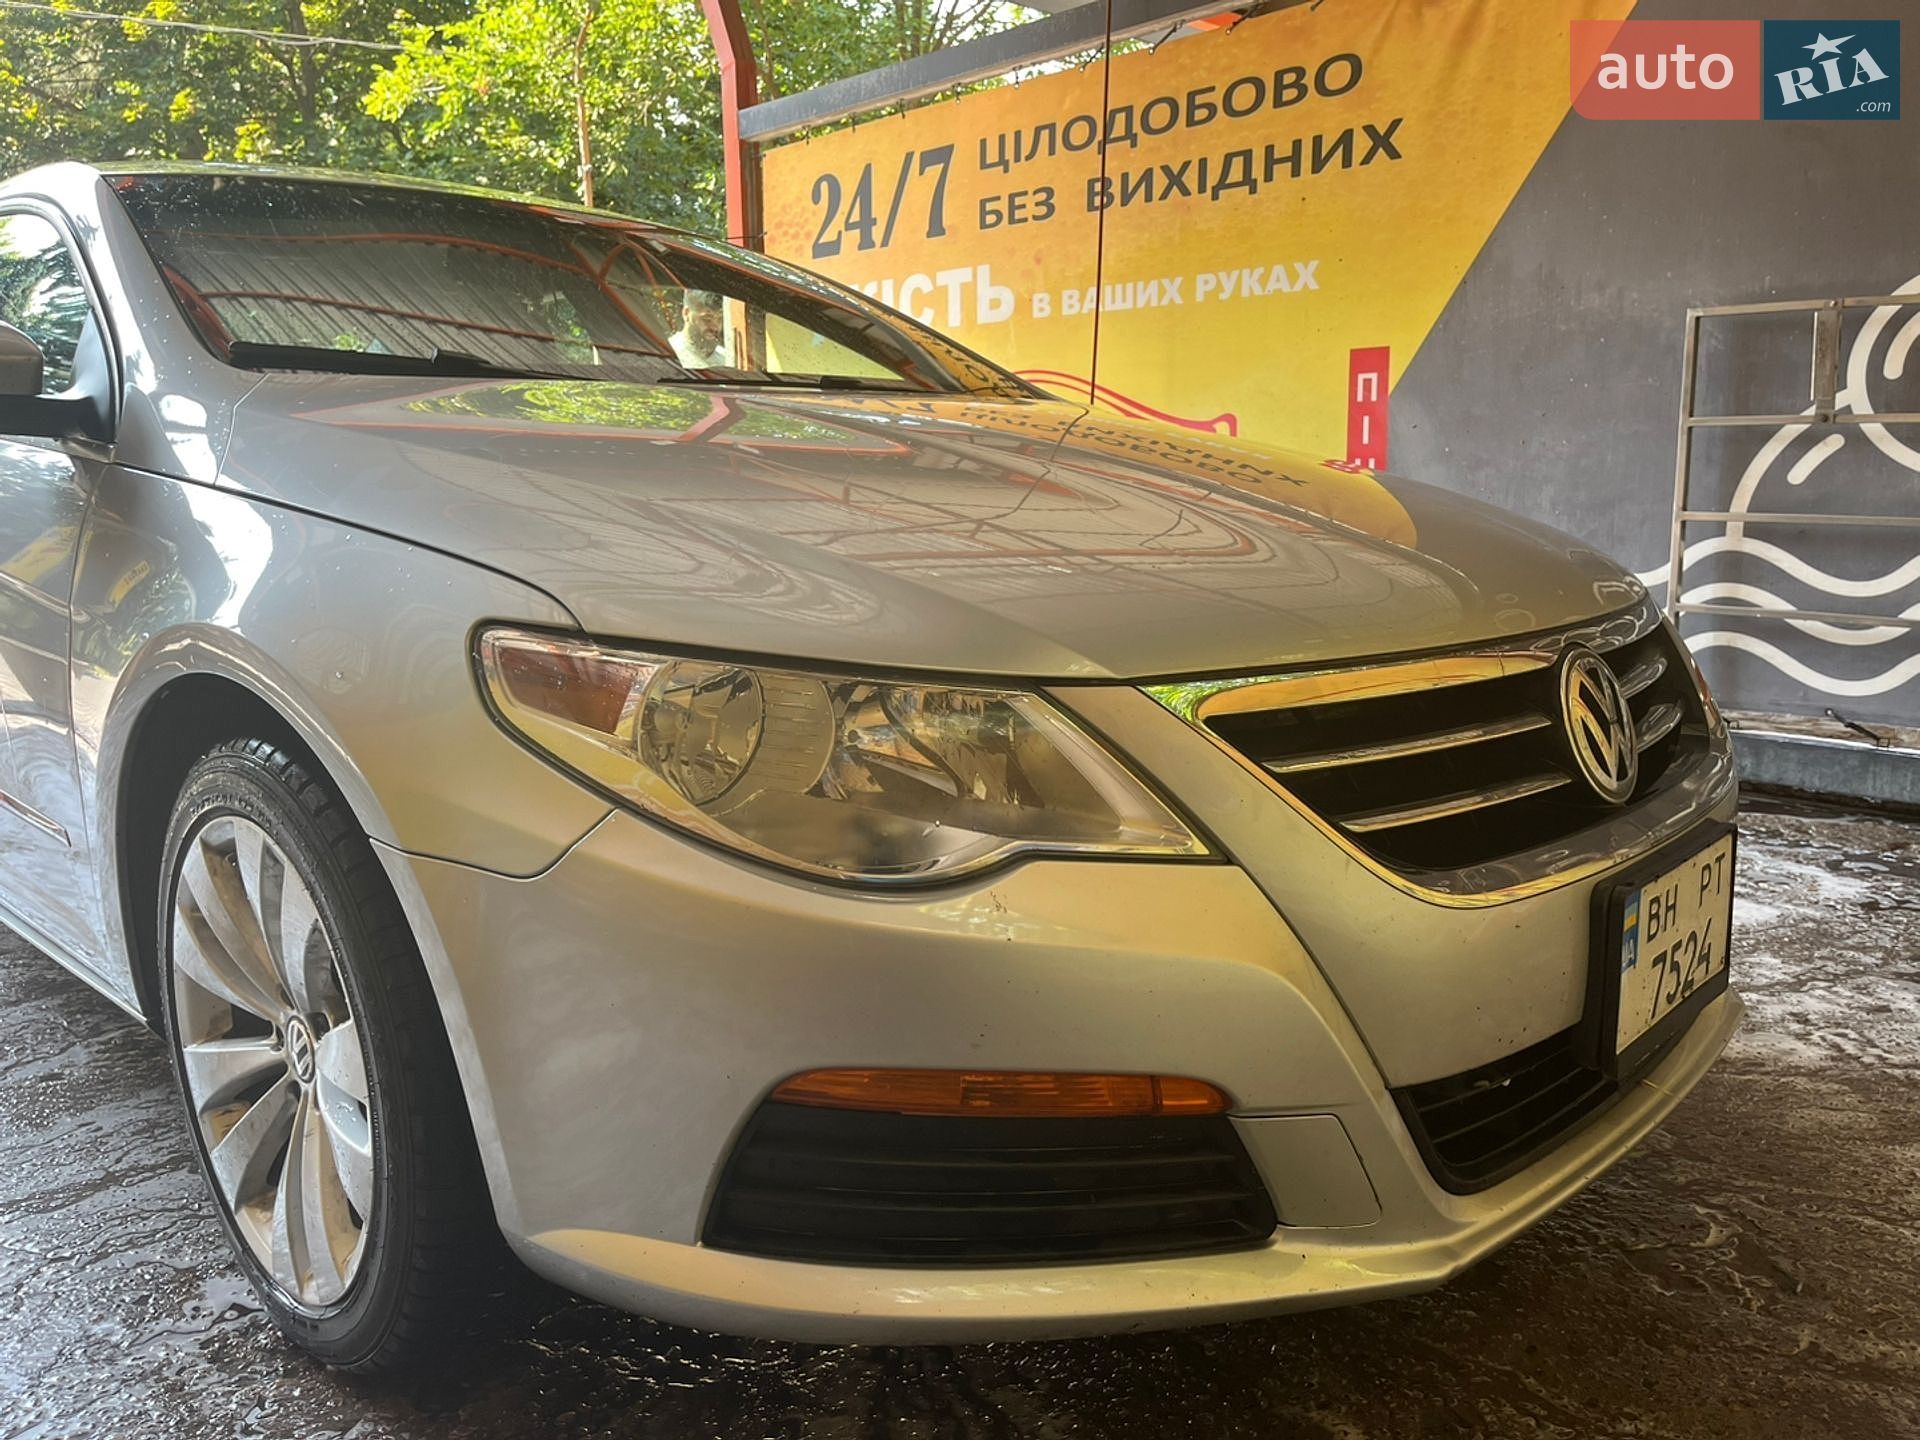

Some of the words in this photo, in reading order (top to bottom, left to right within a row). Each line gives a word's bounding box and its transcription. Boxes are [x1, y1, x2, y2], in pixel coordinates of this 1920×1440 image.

[978, 53, 1363, 174] ЦІЛОДОБОВО
[811, 143, 955, 259] 24/7
[978, 186, 1056, 230] БЕЗ
[1086, 117, 1404, 212] ВИХІДНИХ
[1032, 292, 1051, 318] В
[1061, 277, 1183, 316] ВАШИХ
[1195, 260, 1319, 302] РУКАХ
[1646, 884, 1678, 943] BH
[1699, 853, 1726, 910] PT
[1651, 918, 1712, 1020] 7524
